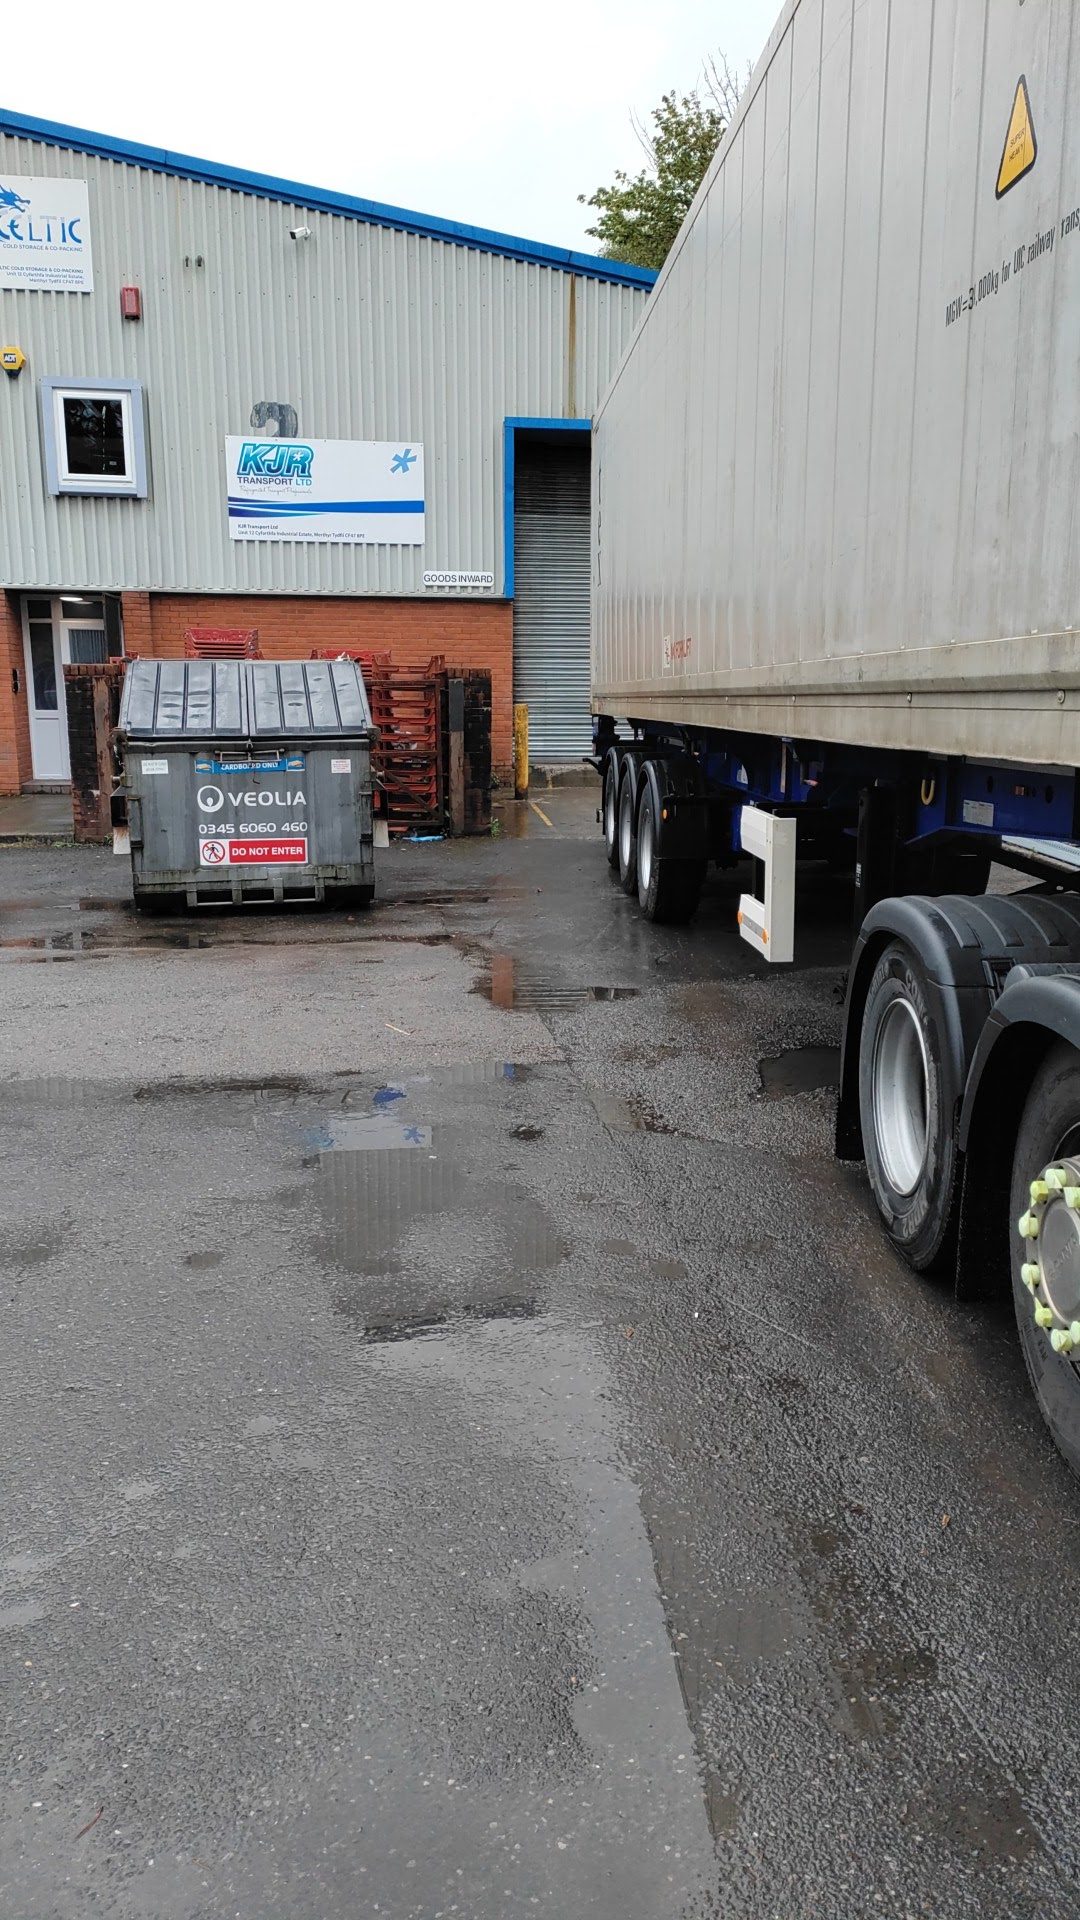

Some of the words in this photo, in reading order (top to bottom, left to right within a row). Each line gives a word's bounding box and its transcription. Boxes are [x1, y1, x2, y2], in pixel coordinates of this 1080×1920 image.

[1010, 127, 1025, 148] SUPER
[1001, 261, 1011, 284] for
[1027, 227, 1055, 264] railway
[237, 443, 314, 478] KJR
[238, 477, 293, 485] TRANSPORT
[423, 574, 456, 582] GOODS
[459, 575, 493, 583] INWARD
[228, 790, 307, 807] VEOLIA
[199, 823, 235, 834] 0345
[239, 822, 277, 833] 6060
[281, 821, 308, 832] 460
[232, 848, 246, 856] DO
[248, 847, 269, 855] NOT
[271, 846, 303, 855] ENTER
